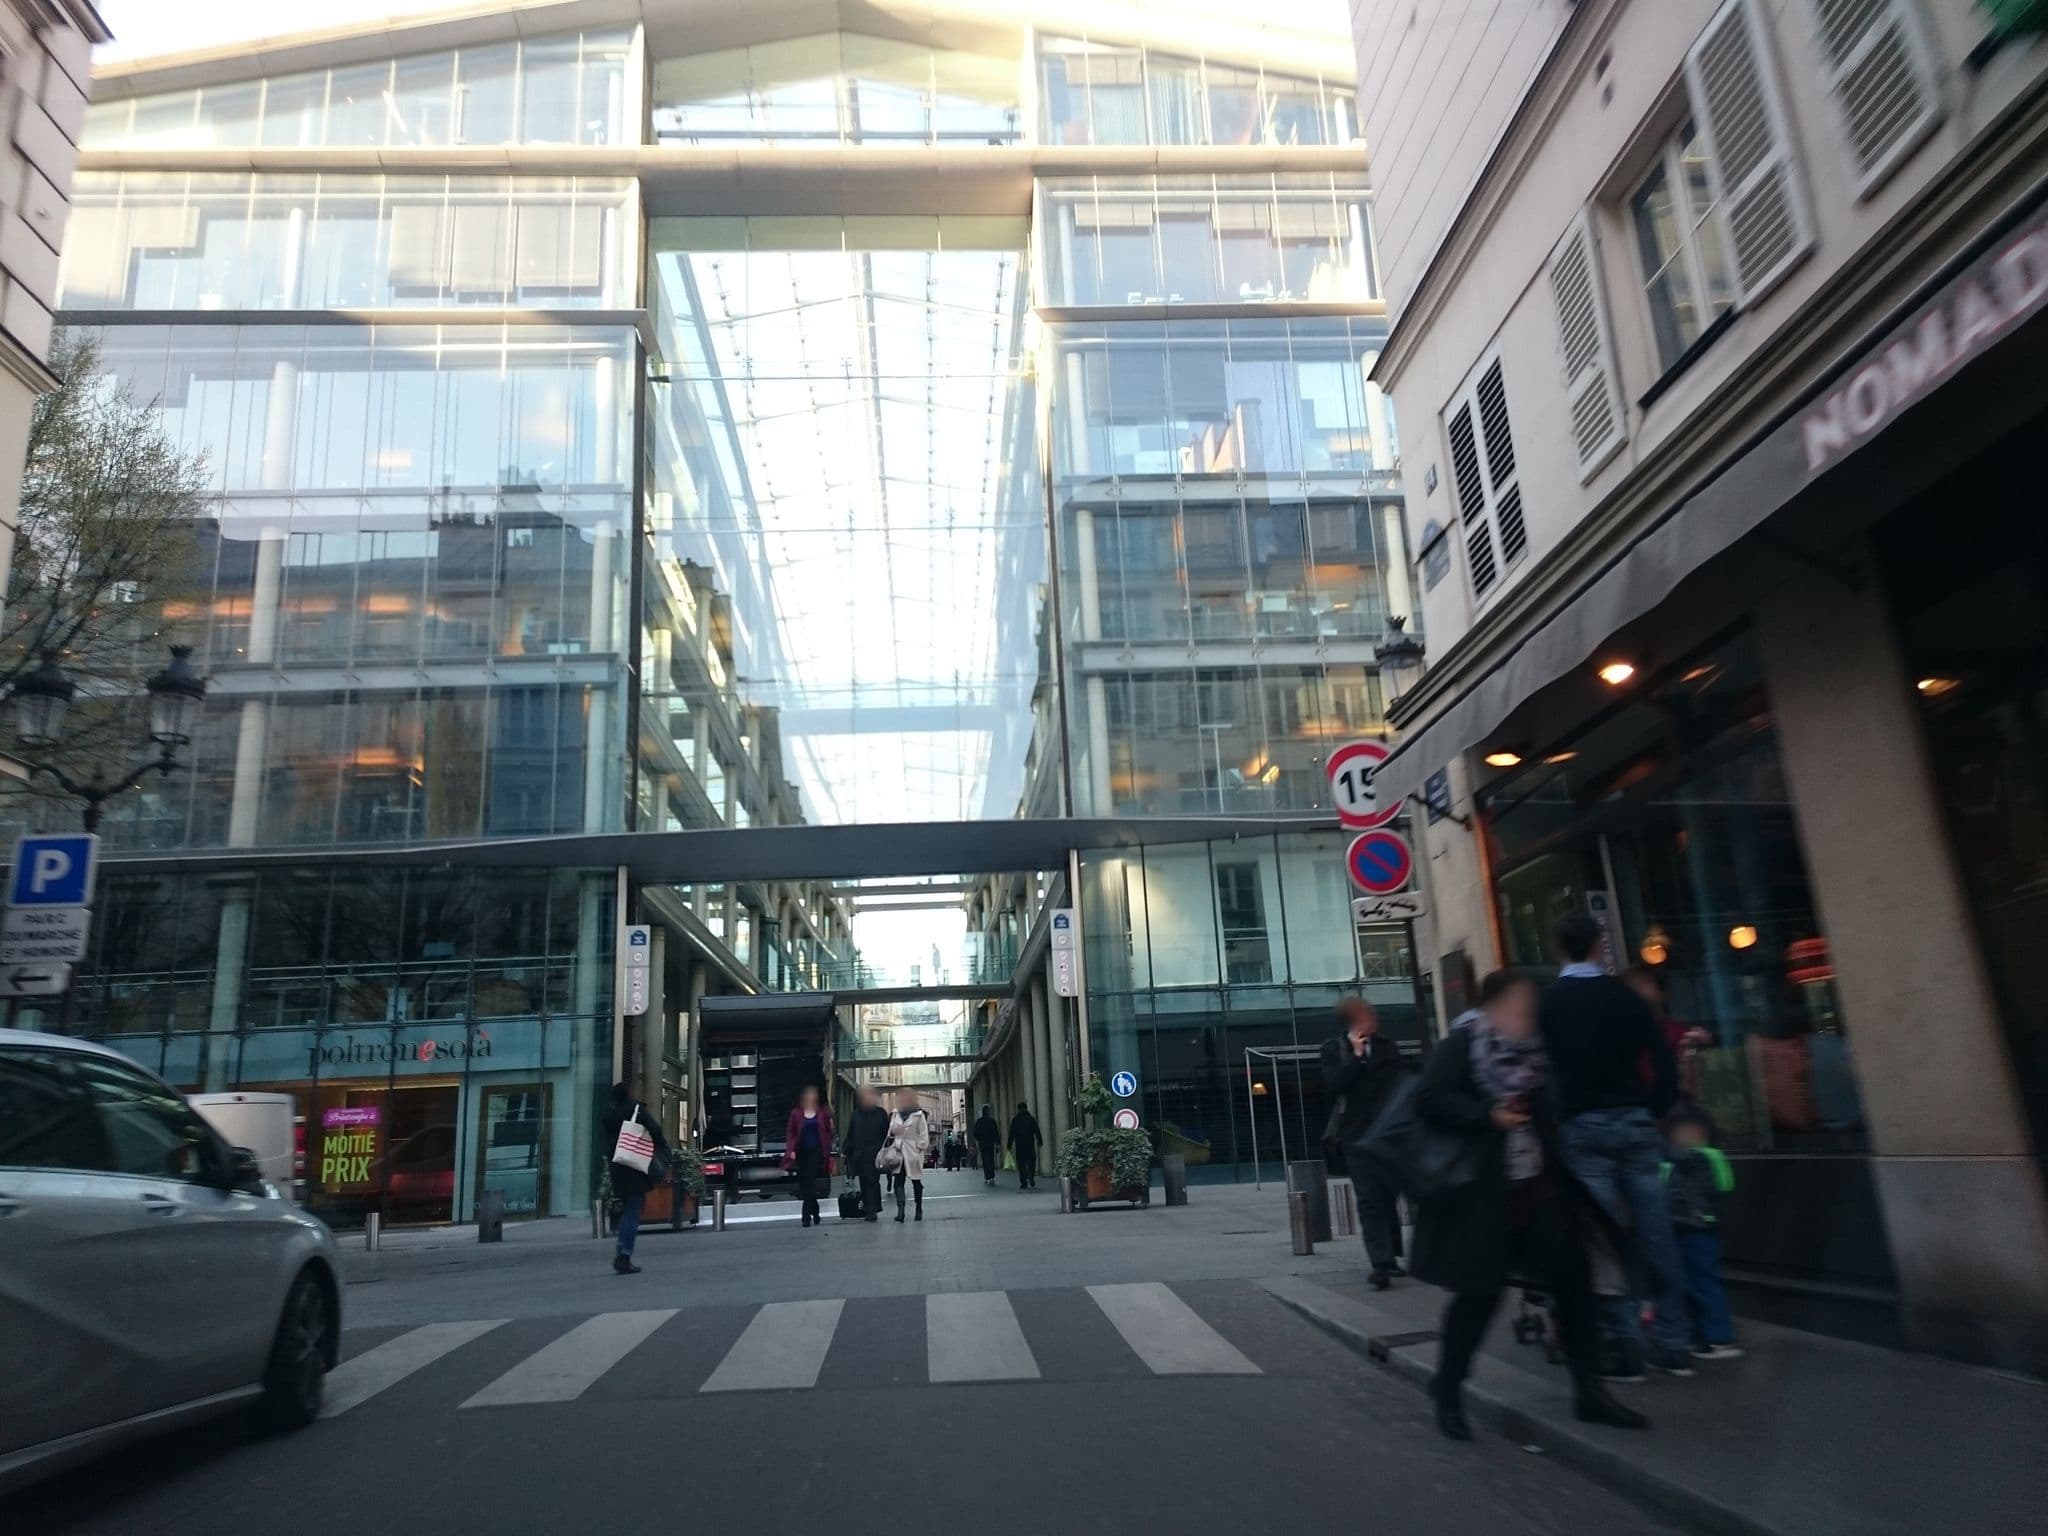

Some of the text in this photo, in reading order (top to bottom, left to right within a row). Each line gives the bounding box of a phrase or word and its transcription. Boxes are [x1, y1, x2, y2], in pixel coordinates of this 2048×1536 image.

[30, 848, 72, 894] P
[324, 1130, 376, 1155] MOITIÉ
[321, 1156, 370, 1183] PRIX
